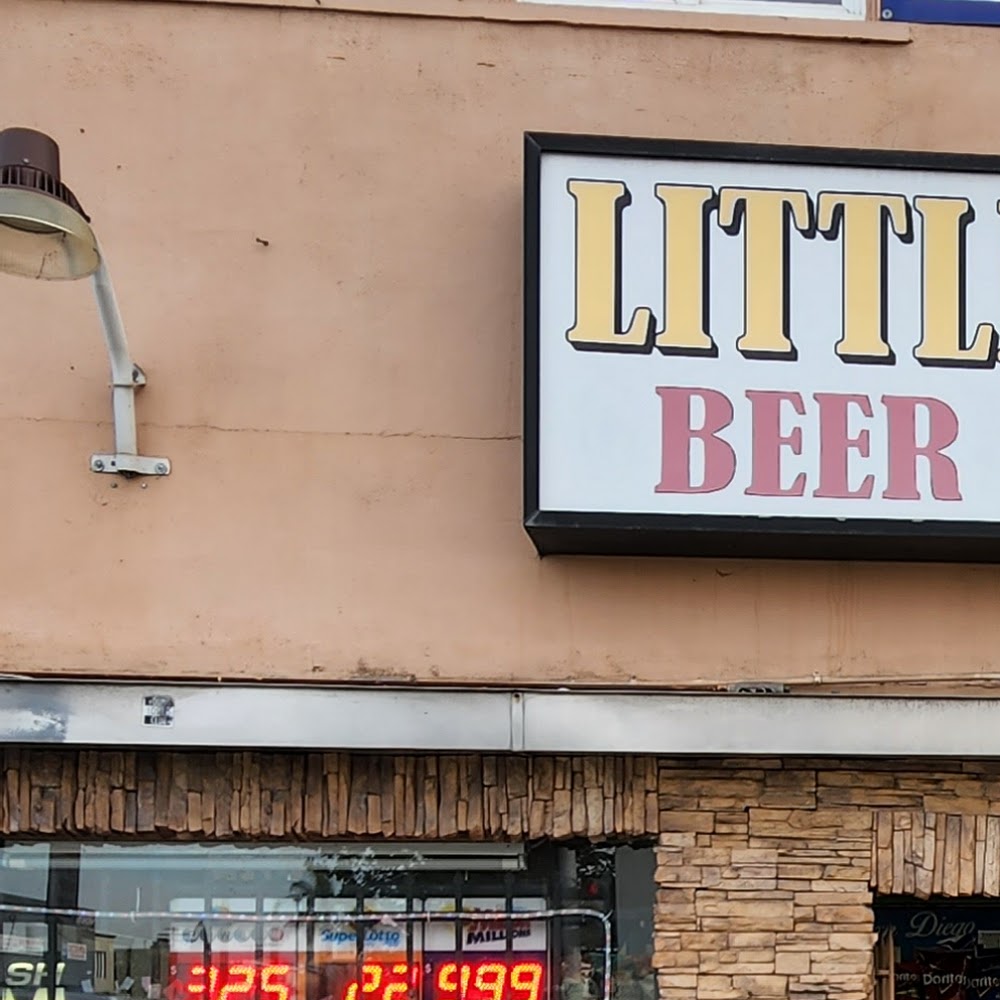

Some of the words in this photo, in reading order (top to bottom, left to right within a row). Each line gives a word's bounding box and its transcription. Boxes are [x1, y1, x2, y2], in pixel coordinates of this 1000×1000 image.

[655, 386, 962, 501] BEER
[467, 929, 531, 945] MILLONS
[905, 911, 976, 945] Diego
